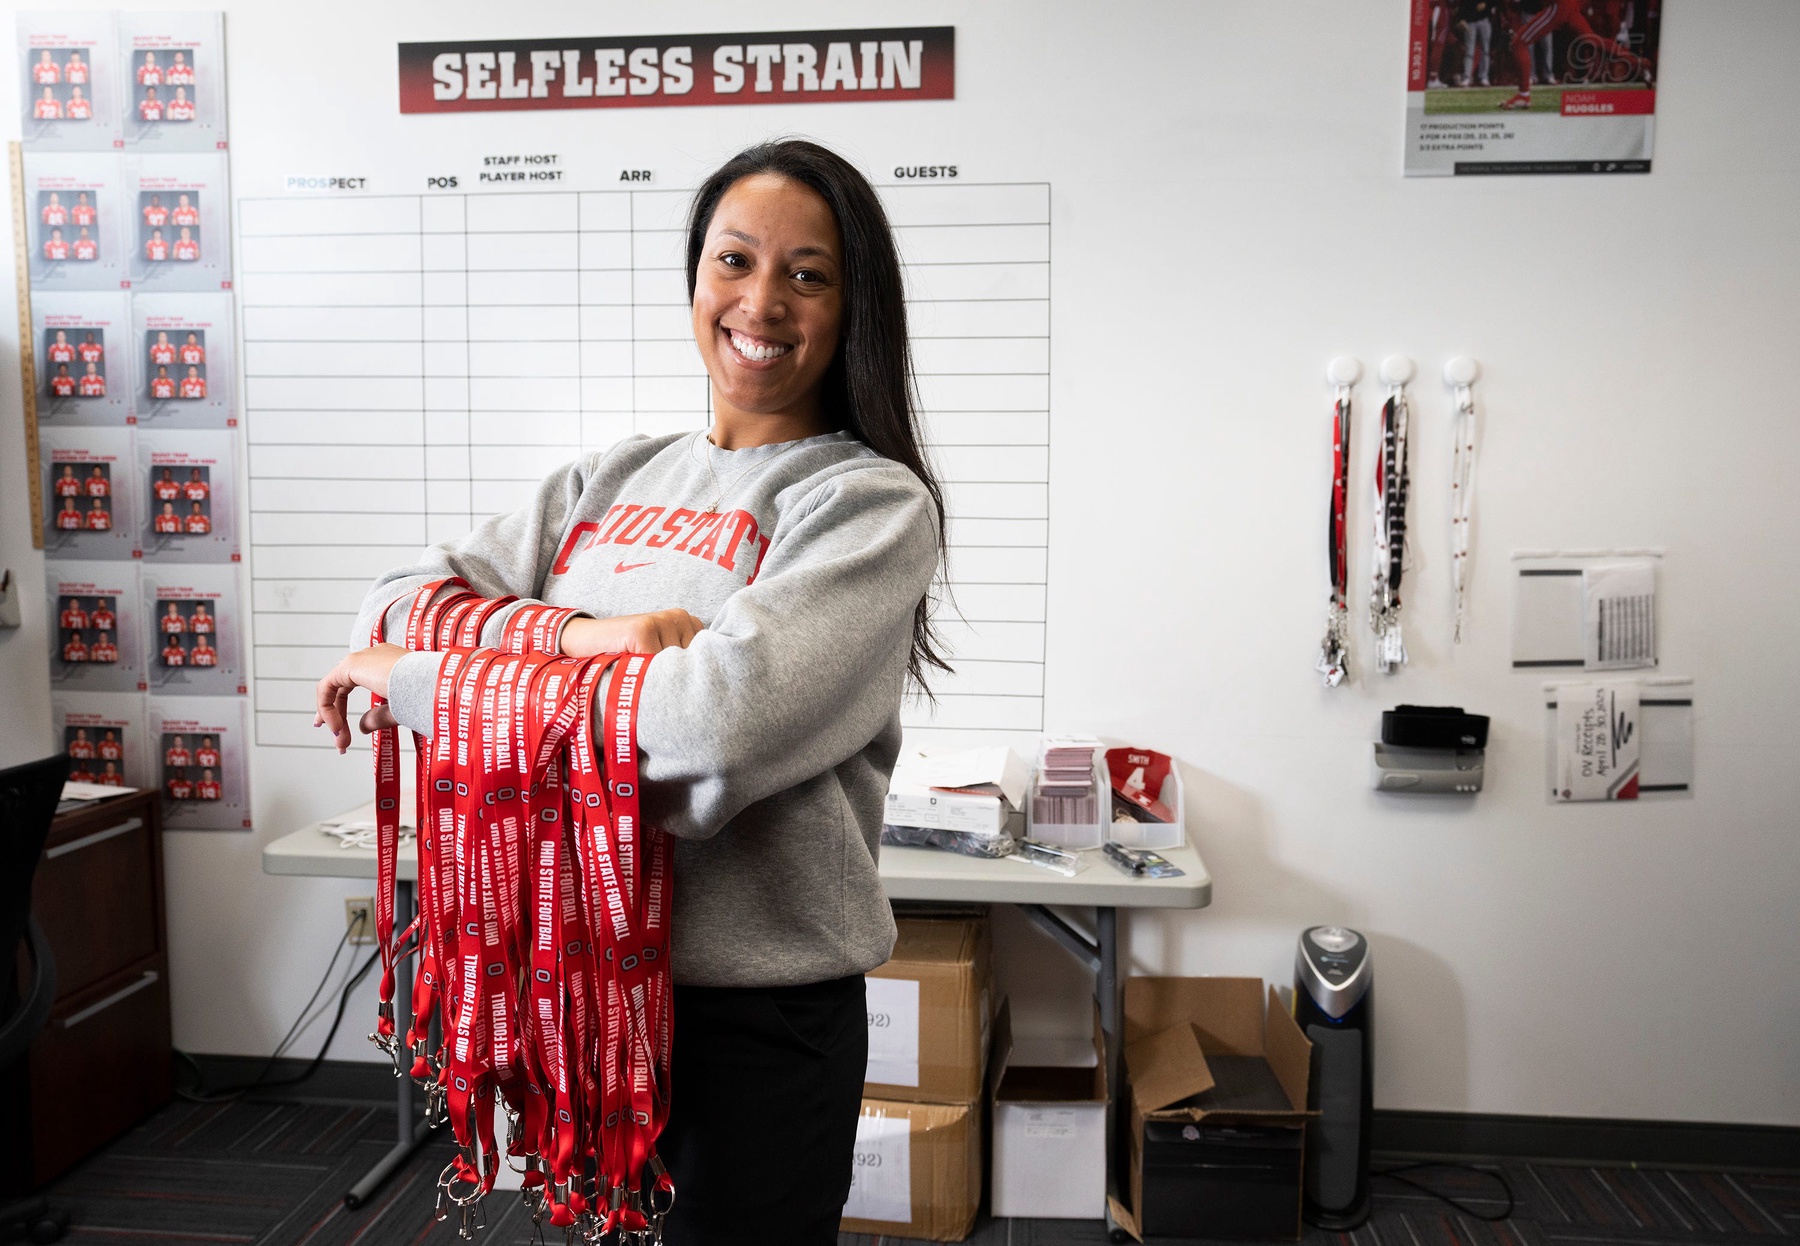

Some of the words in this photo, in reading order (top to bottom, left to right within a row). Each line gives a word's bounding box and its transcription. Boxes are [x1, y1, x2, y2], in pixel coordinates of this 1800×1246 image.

[432, 45, 694, 101] SELFLESS
[712, 40, 924, 94] STRAIN
[1563, 33, 1645, 85] 95
[1565, 103, 1614, 113] RUGGLES
[483, 155, 520, 166] STAFF
[524, 154, 559, 165] HOST
[894, 166, 958, 179] GUESTS
[287, 177, 368, 189] PROSPECT
[428, 177, 458, 189] POS
[479, 170, 525, 181] PLAYER
[529, 170, 563, 181] HOST
[620, 170, 651, 181] ARR
[516, 610, 535, 629] OHIO
[536, 609, 556, 626] OHIO
[511, 630, 524, 655] STAT
[444, 653, 462, 676] OHIO
[486, 664, 504, 687] OHIO
[502, 660, 519, 683] OHIO
[581, 663, 601, 685] OHIO
[626, 657, 645, 675] OHIO
[438, 677, 452, 710] STATE
[460, 658, 487, 708] FOOTBALL
[544, 675, 562, 700] OHIO
[617, 676, 637, 709] STATE
[482, 688, 495, 721] STATE
[498, 684, 511, 717] STATE
[437, 711, 451, 761] FOOTBALL
[458, 709, 470, 740] STATE
[616, 710, 631, 764] FOOTBALL
[458, 741, 469, 766] OHIO
[496, 718, 511, 770] FOOTBALL
[1127, 753, 1150, 766] SMITH
[1125, 767, 1146, 790] 4
[439, 808, 453, 832] OHIO
[503, 817, 518, 842] OHIO
[618, 816, 633, 842] OHIO
[382, 825, 393, 847] OHIO
[440, 833, 455, 865] STATE
[593, 825, 609, 852] OHIO
[382, 848, 393, 876] STATE
[506, 843, 519, 874] STATE
[540, 841, 555, 865] OHIO
[619, 844, 633, 877] STATE
[539, 866, 554, 899] STATE
[598, 853, 617, 887] STATE
[383, 877, 394, 920] FOOTBALL
[441, 866, 455, 915] FOOTBALL
[560, 872, 578, 924] FOOTBALL
[647, 879, 662, 929] FOOTBALL
[483, 890, 497, 920] STATE
[605, 886, 630, 941] FOOTBALL
[484, 922, 499, 946] OHIO
[538, 900, 552, 950] FOOTBALL
[464, 953, 479, 1002] FOOTBALL
[571, 971, 582, 997] OHIO
[538, 998, 553, 1019] OHIO
[631, 984, 645, 1010] OHIO
[458, 1003, 473, 1036] STATE
[491, 992, 507, 1041] FOOTBALL
[576, 996, 586, 1030] STATE
[608, 1006, 620, 1040] STATE
[541, 1020, 557, 1046] STATE
[455, 1036, 469, 1062] OHIO
[495, 1041, 509, 1070] STATE
[559, 1065, 567, 1093] OHIO
[605, 1041, 618, 1096] FOOTBALL
